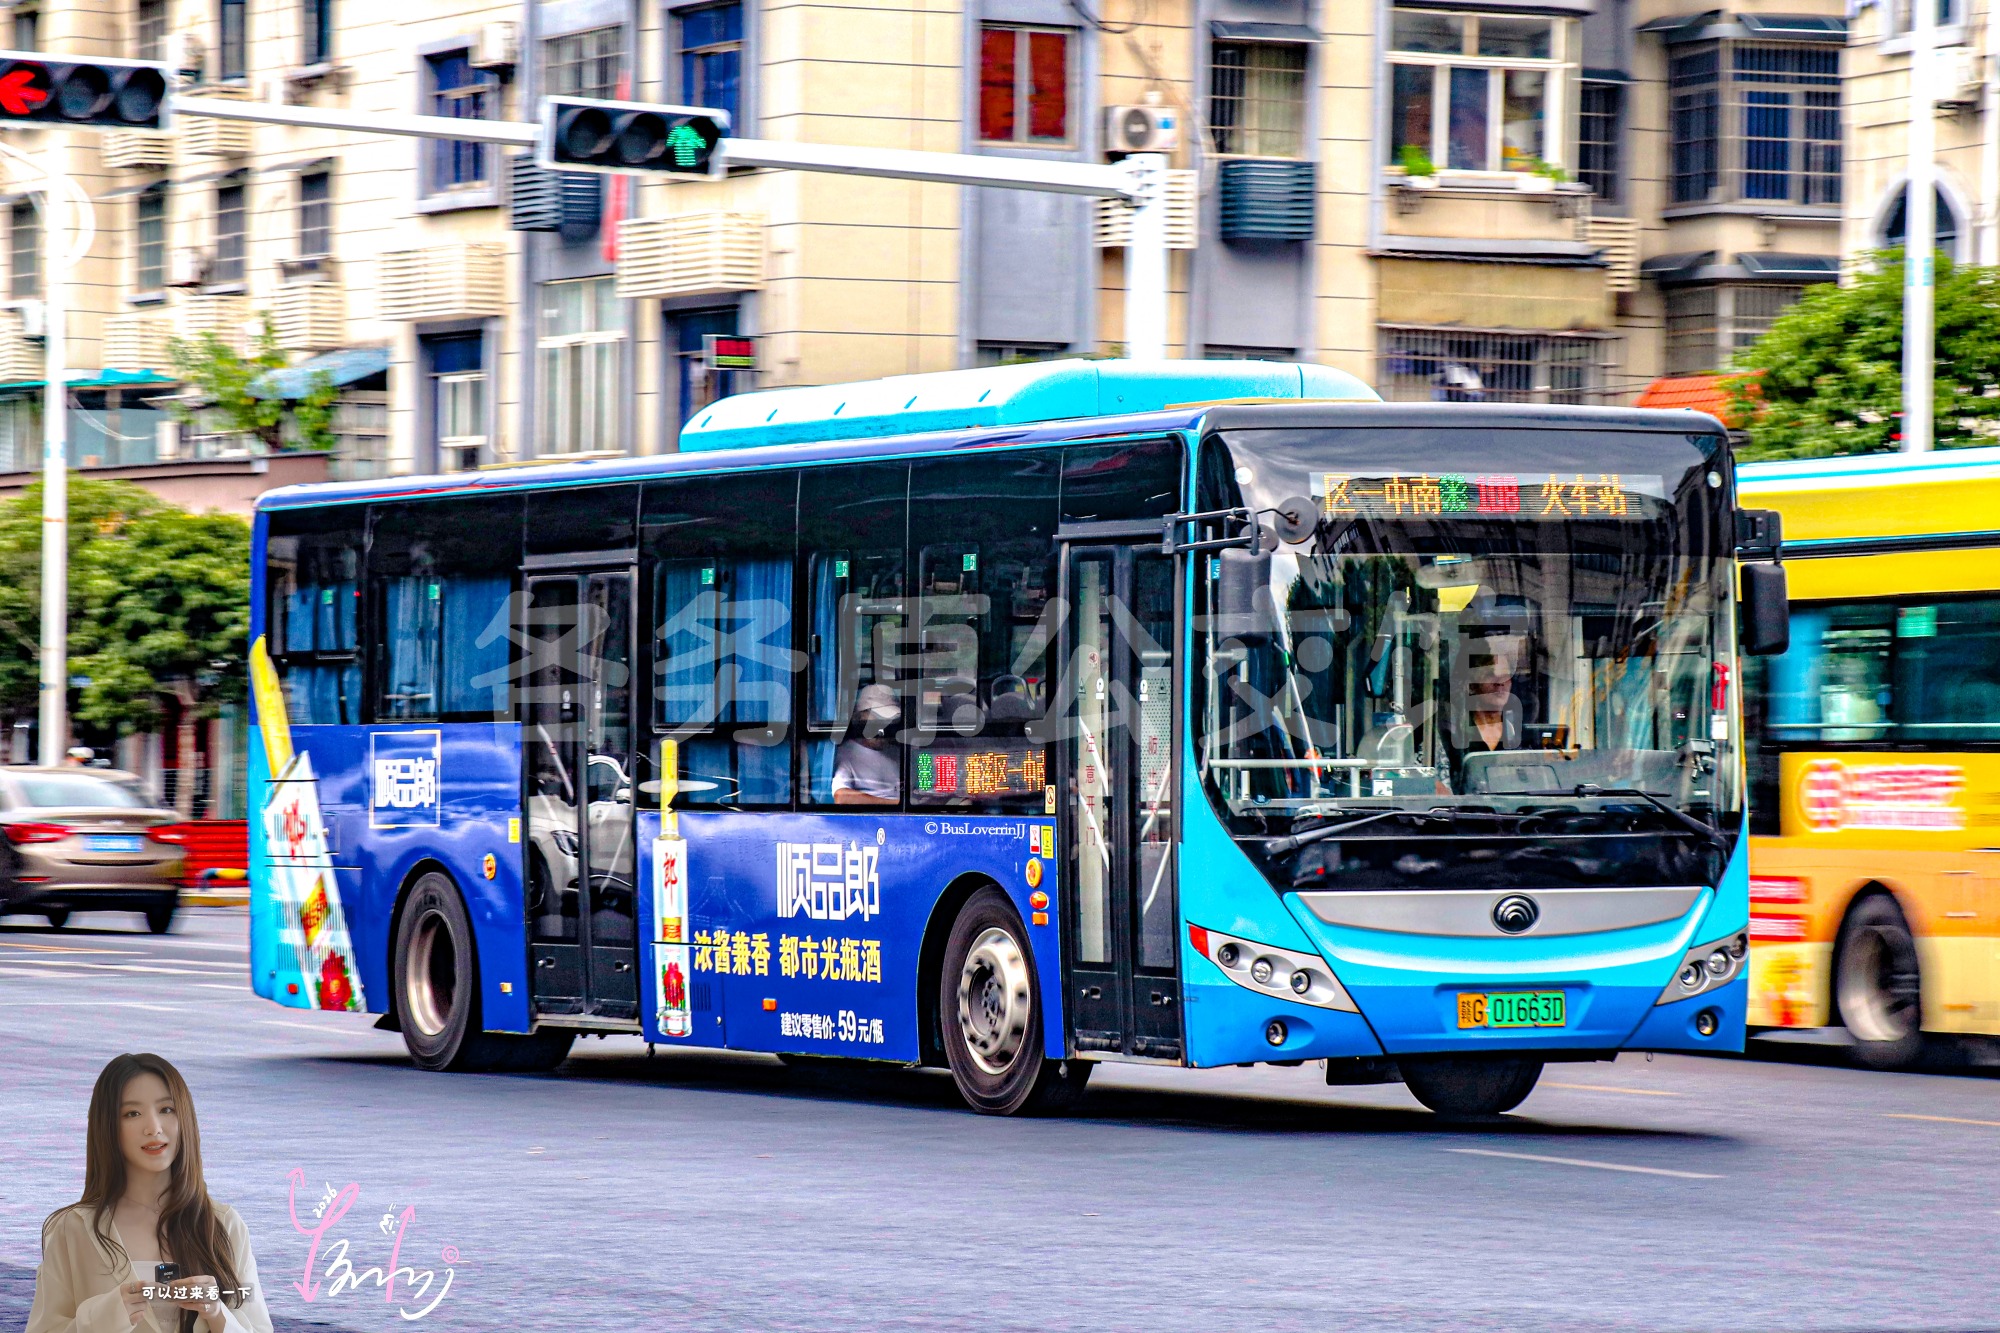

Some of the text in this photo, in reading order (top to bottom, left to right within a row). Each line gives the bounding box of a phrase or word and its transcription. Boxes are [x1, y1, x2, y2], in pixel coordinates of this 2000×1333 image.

[1541, 473, 1627, 515] 火车站
[1085, 733, 1096, 846] 注意开门
[776, 840, 880, 922] 顺品郎
[693, 930, 882, 984] 浓酱兼香 都市光瓶酒
